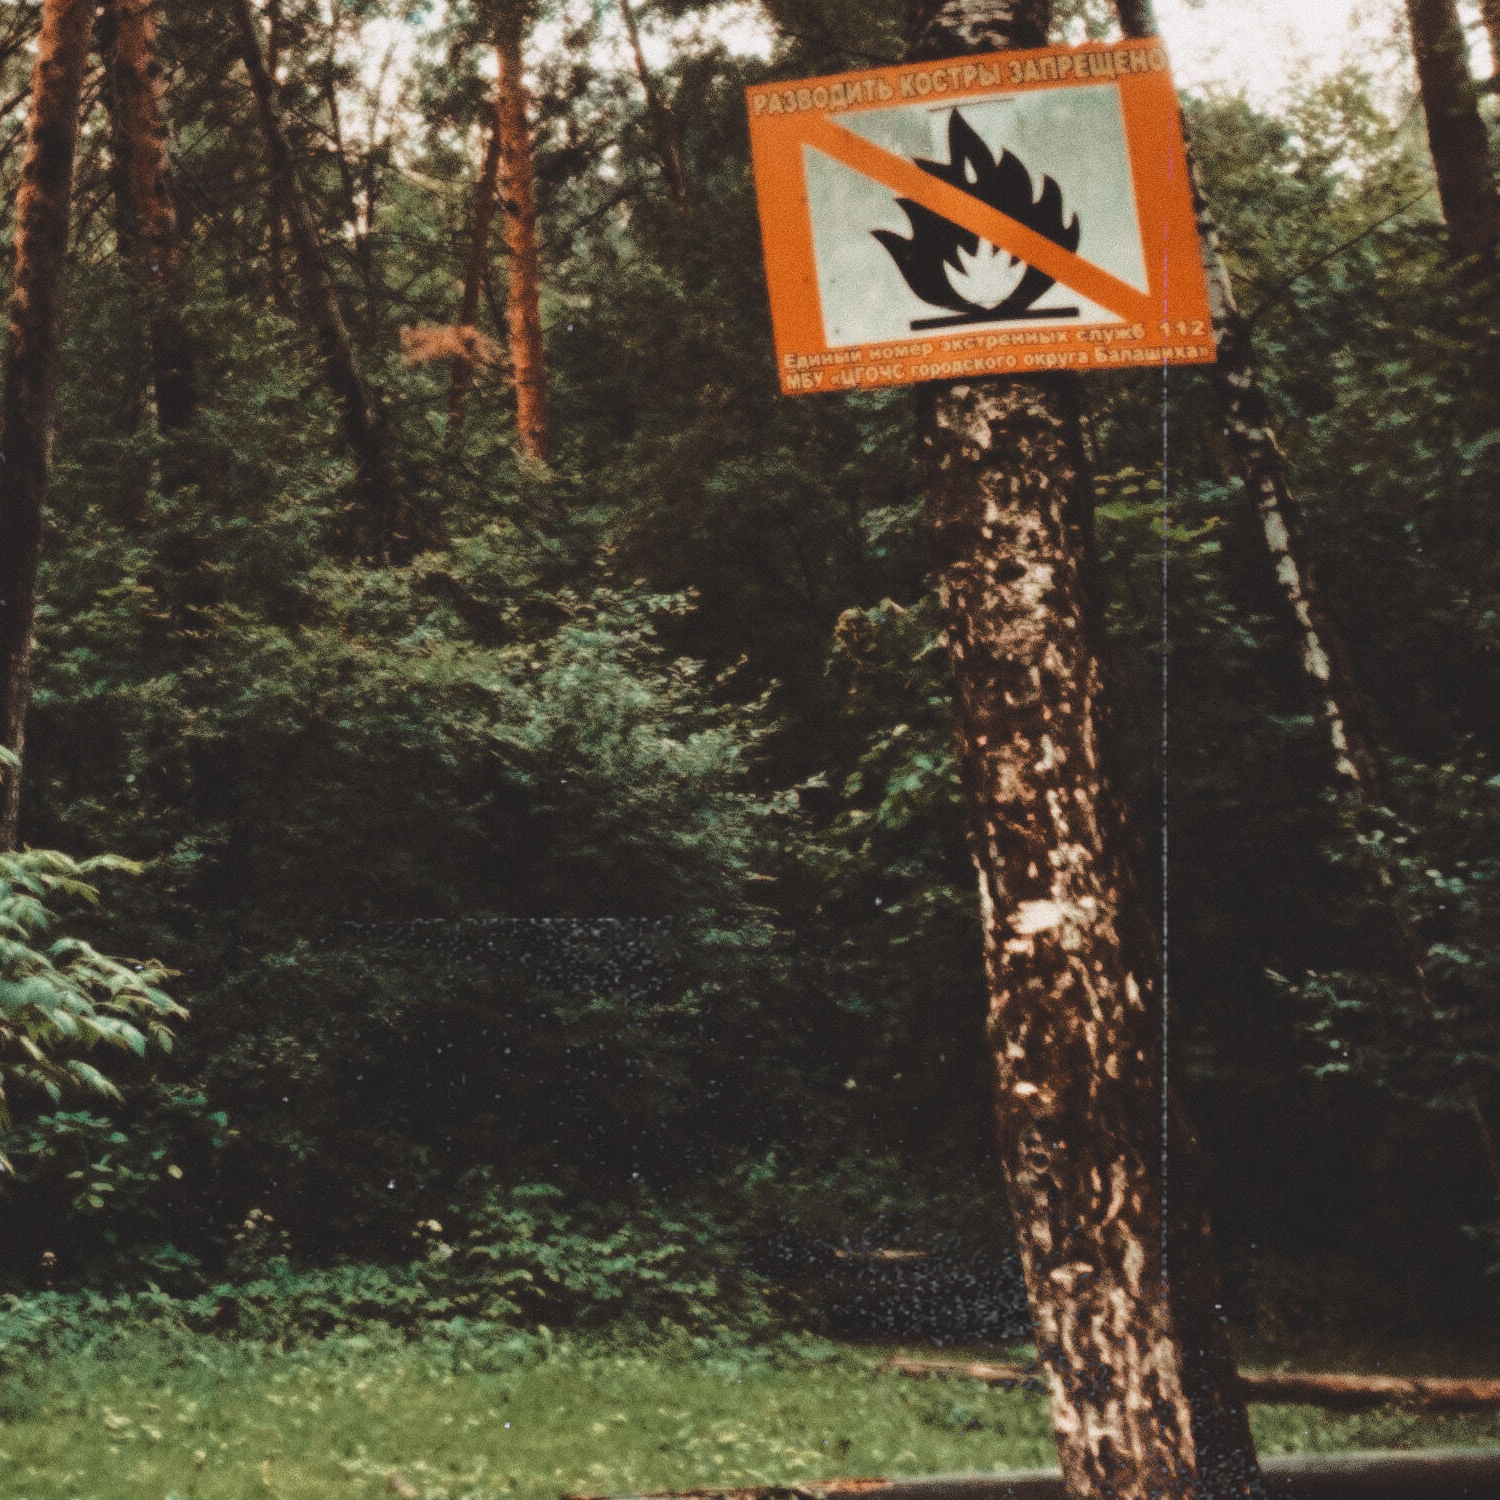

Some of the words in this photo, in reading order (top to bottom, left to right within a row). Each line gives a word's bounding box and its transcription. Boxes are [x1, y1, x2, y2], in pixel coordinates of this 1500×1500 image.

[752, 77, 895, 116] РАЗВОДИТЬ
[900, 62, 1002, 99] КОСТРЫ
[1008, 47, 1169, 84] ЗАПРЕЩЕНО
[783, 346, 862, 369] Единый
[869, 341, 934, 361] номер
[939, 330, 1068, 353] экстренных
[1076, 322, 1145, 344] служб
[1158, 320, 1206, 337] 112
[786, 371, 823, 390] МБУ
[911, 355, 1017, 379] городского
[1023, 350, 1089, 369] округа
